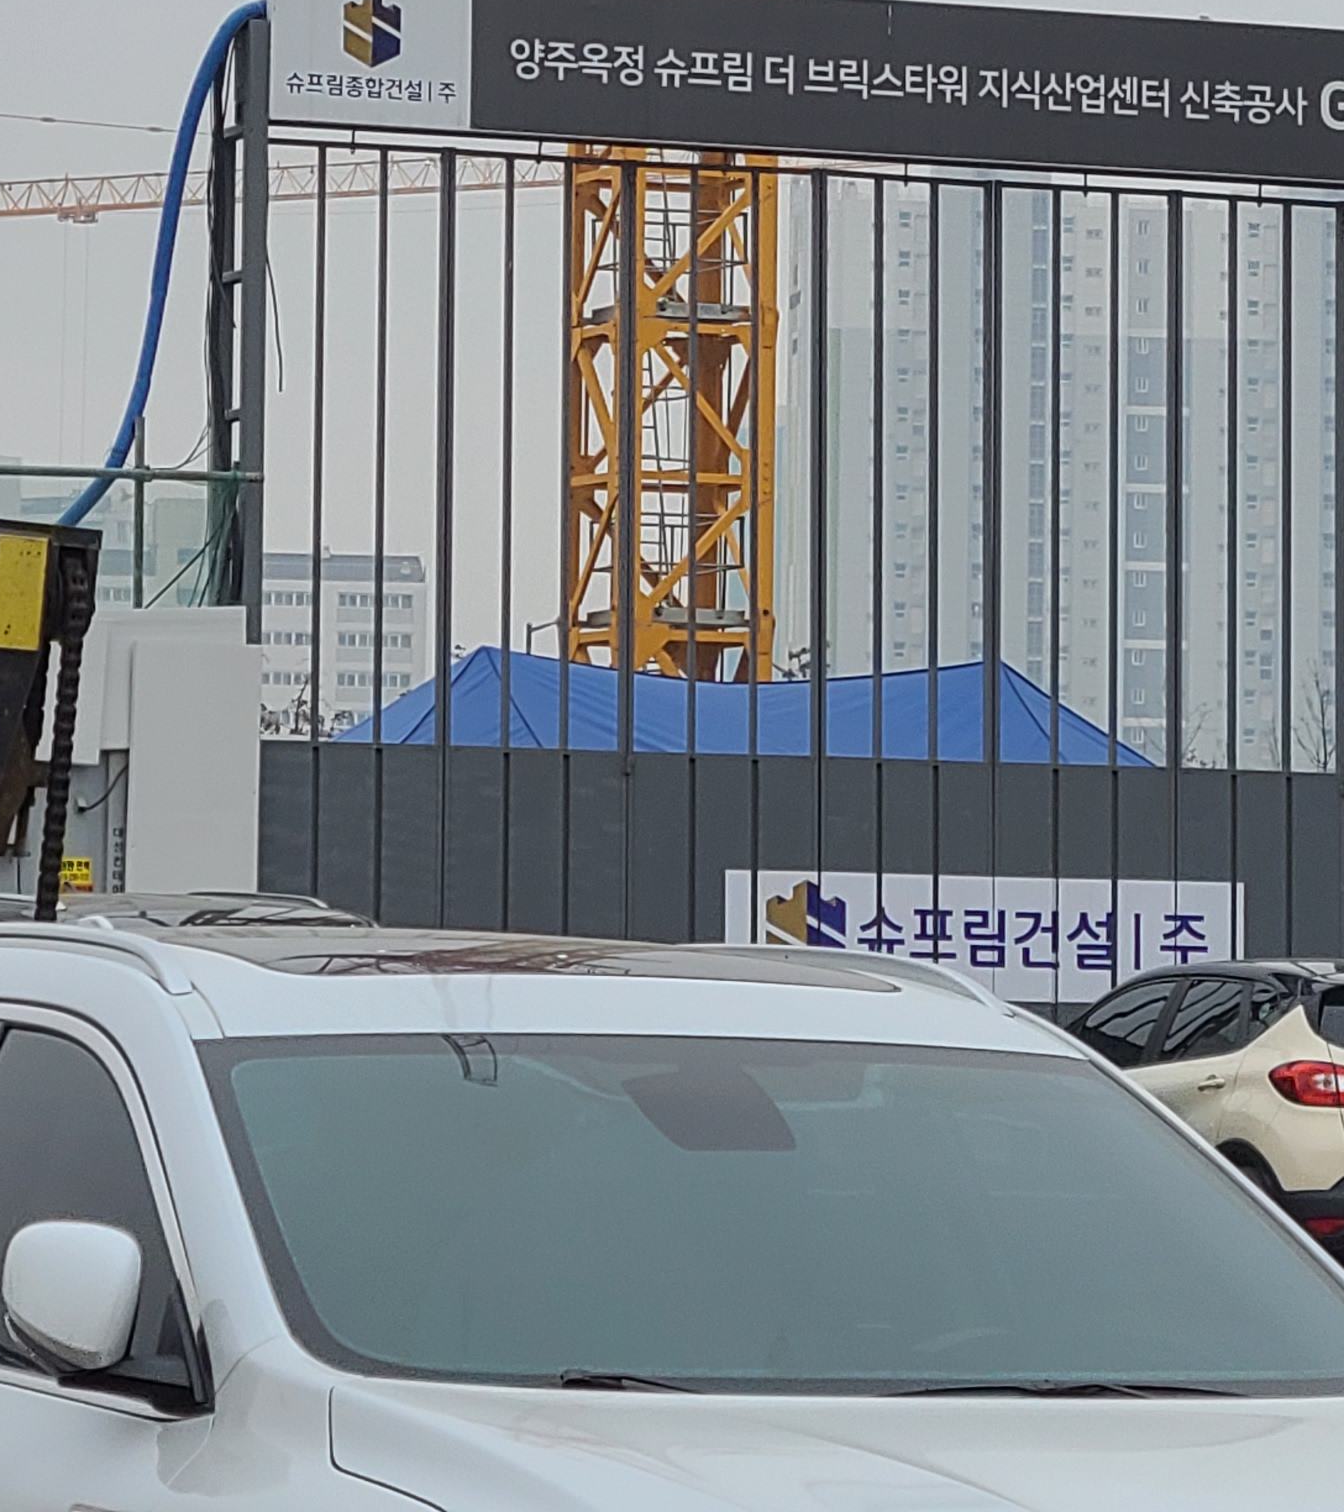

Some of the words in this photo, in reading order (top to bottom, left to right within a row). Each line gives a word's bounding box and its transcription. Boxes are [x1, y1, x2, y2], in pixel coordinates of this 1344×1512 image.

[286, 72, 423, 102] 슈프림종합건설
[510, 36, 646, 90] 양주옥정
[653, 45, 755, 93] 슈프림
[764, 53, 795, 96] 더
[804, 55, 969, 107] 브릭스타워
[977, 69, 1173, 119] 지식산업센터
[1179, 83, 1311, 127] 신축공사
[857, 906, 1118, 971] 슈프림건설
